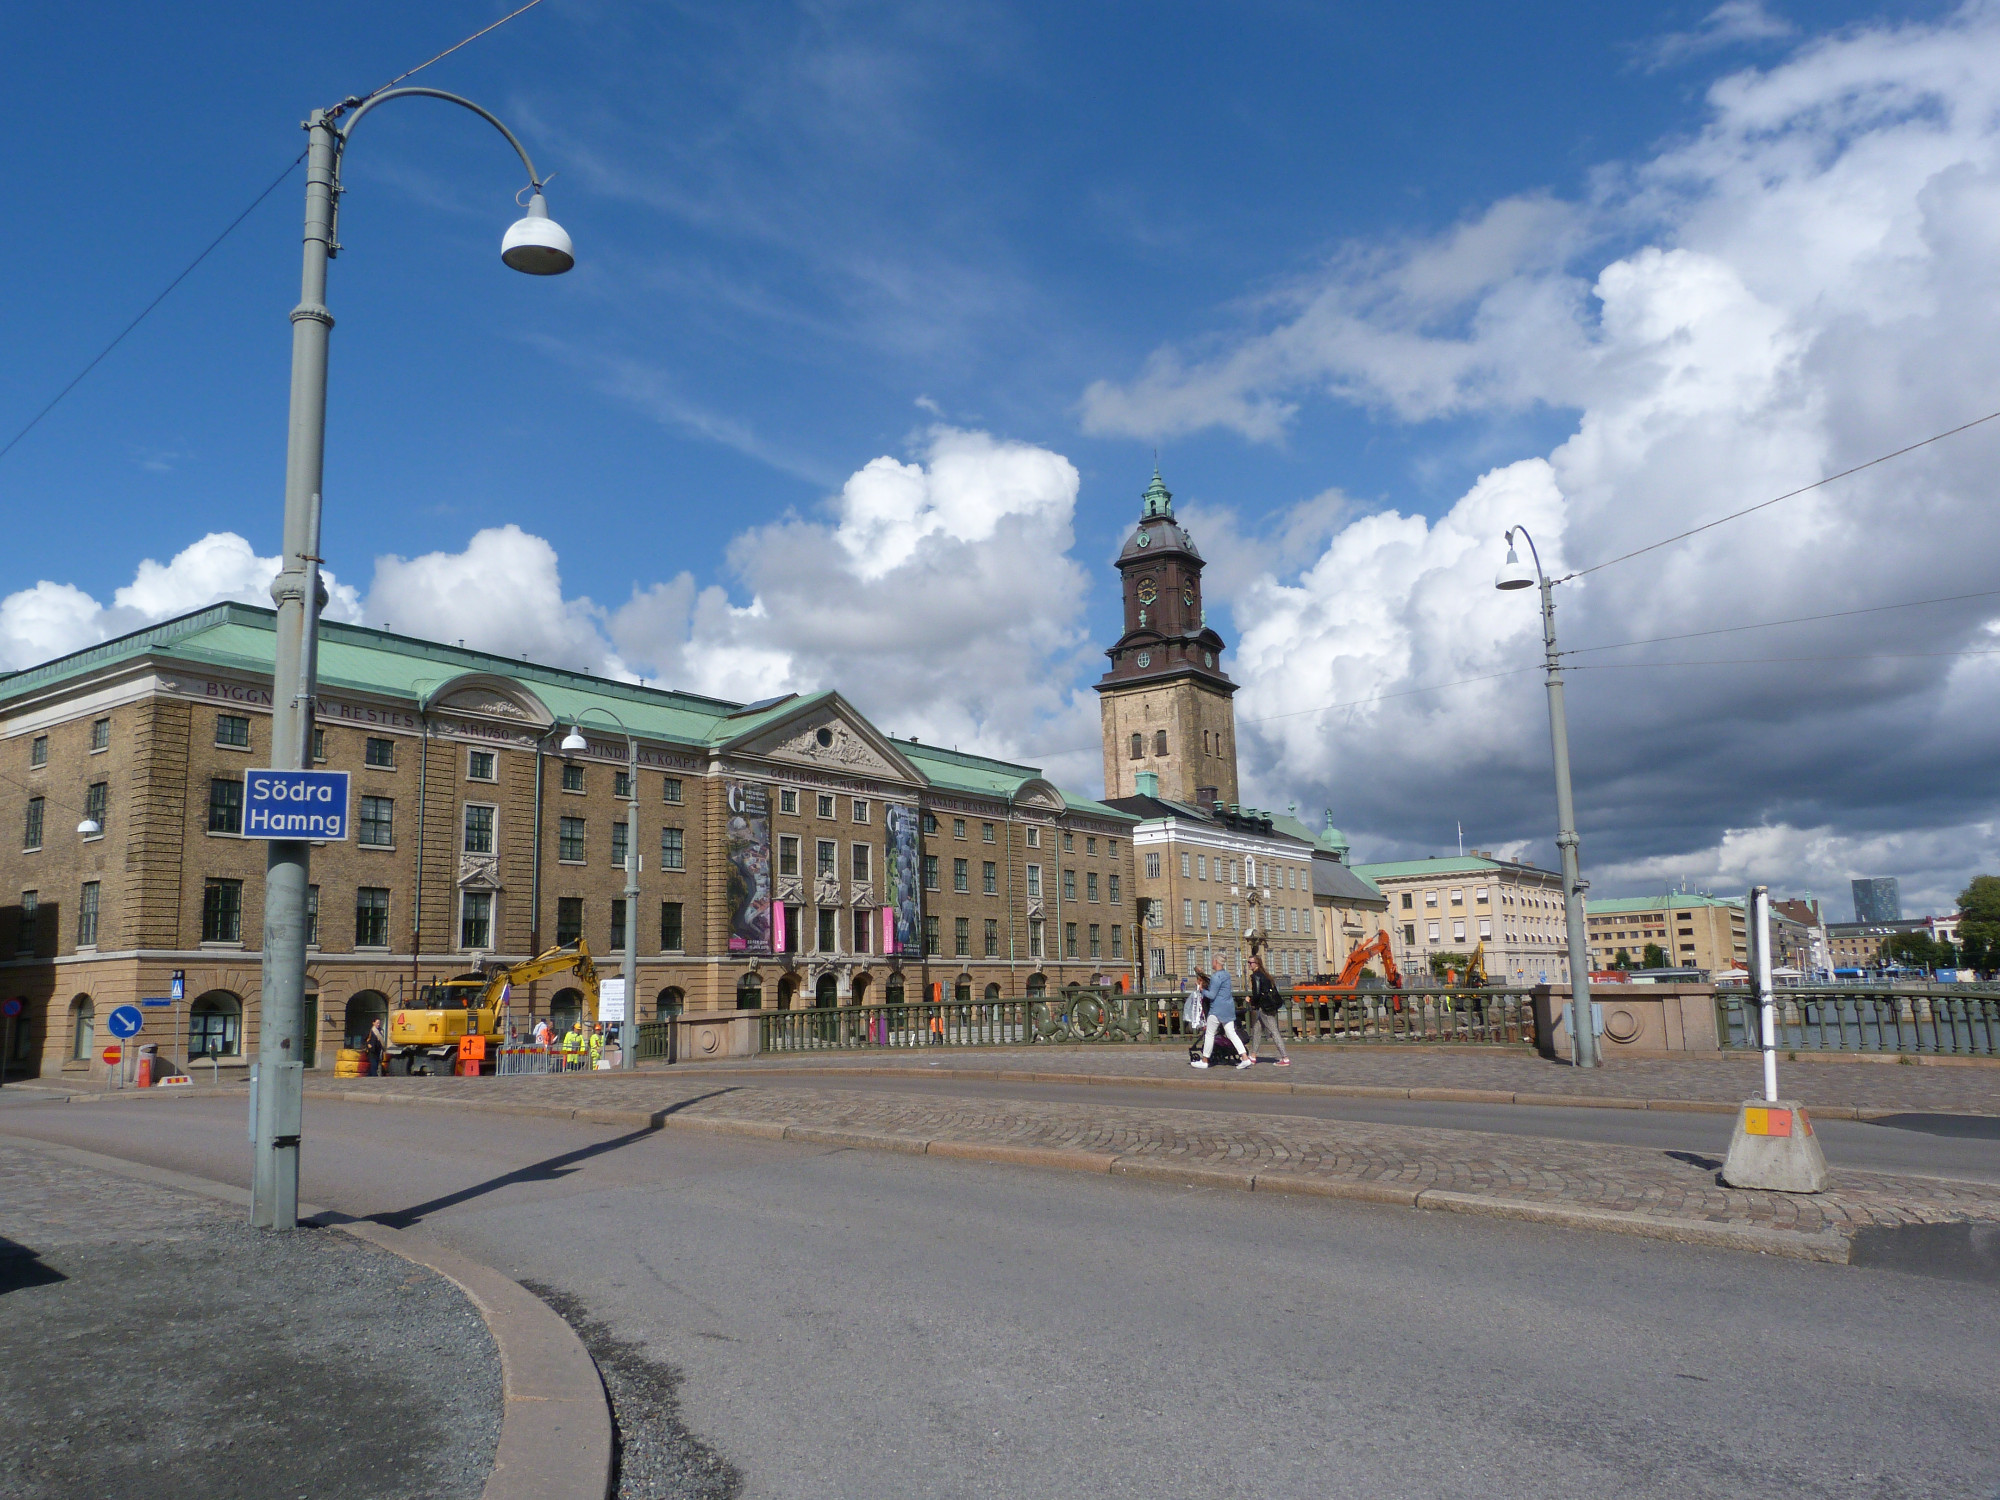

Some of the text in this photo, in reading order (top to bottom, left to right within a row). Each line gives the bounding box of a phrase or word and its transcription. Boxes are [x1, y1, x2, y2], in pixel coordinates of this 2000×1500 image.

[207, 682, 414, 727] BYGGNN RESTES
[482, 726, 509, 740] 1750
[253, 779, 332, 802] Södra
[839, 779, 880, 794] MUSEUM
[251, 809, 340, 836] Hamng
